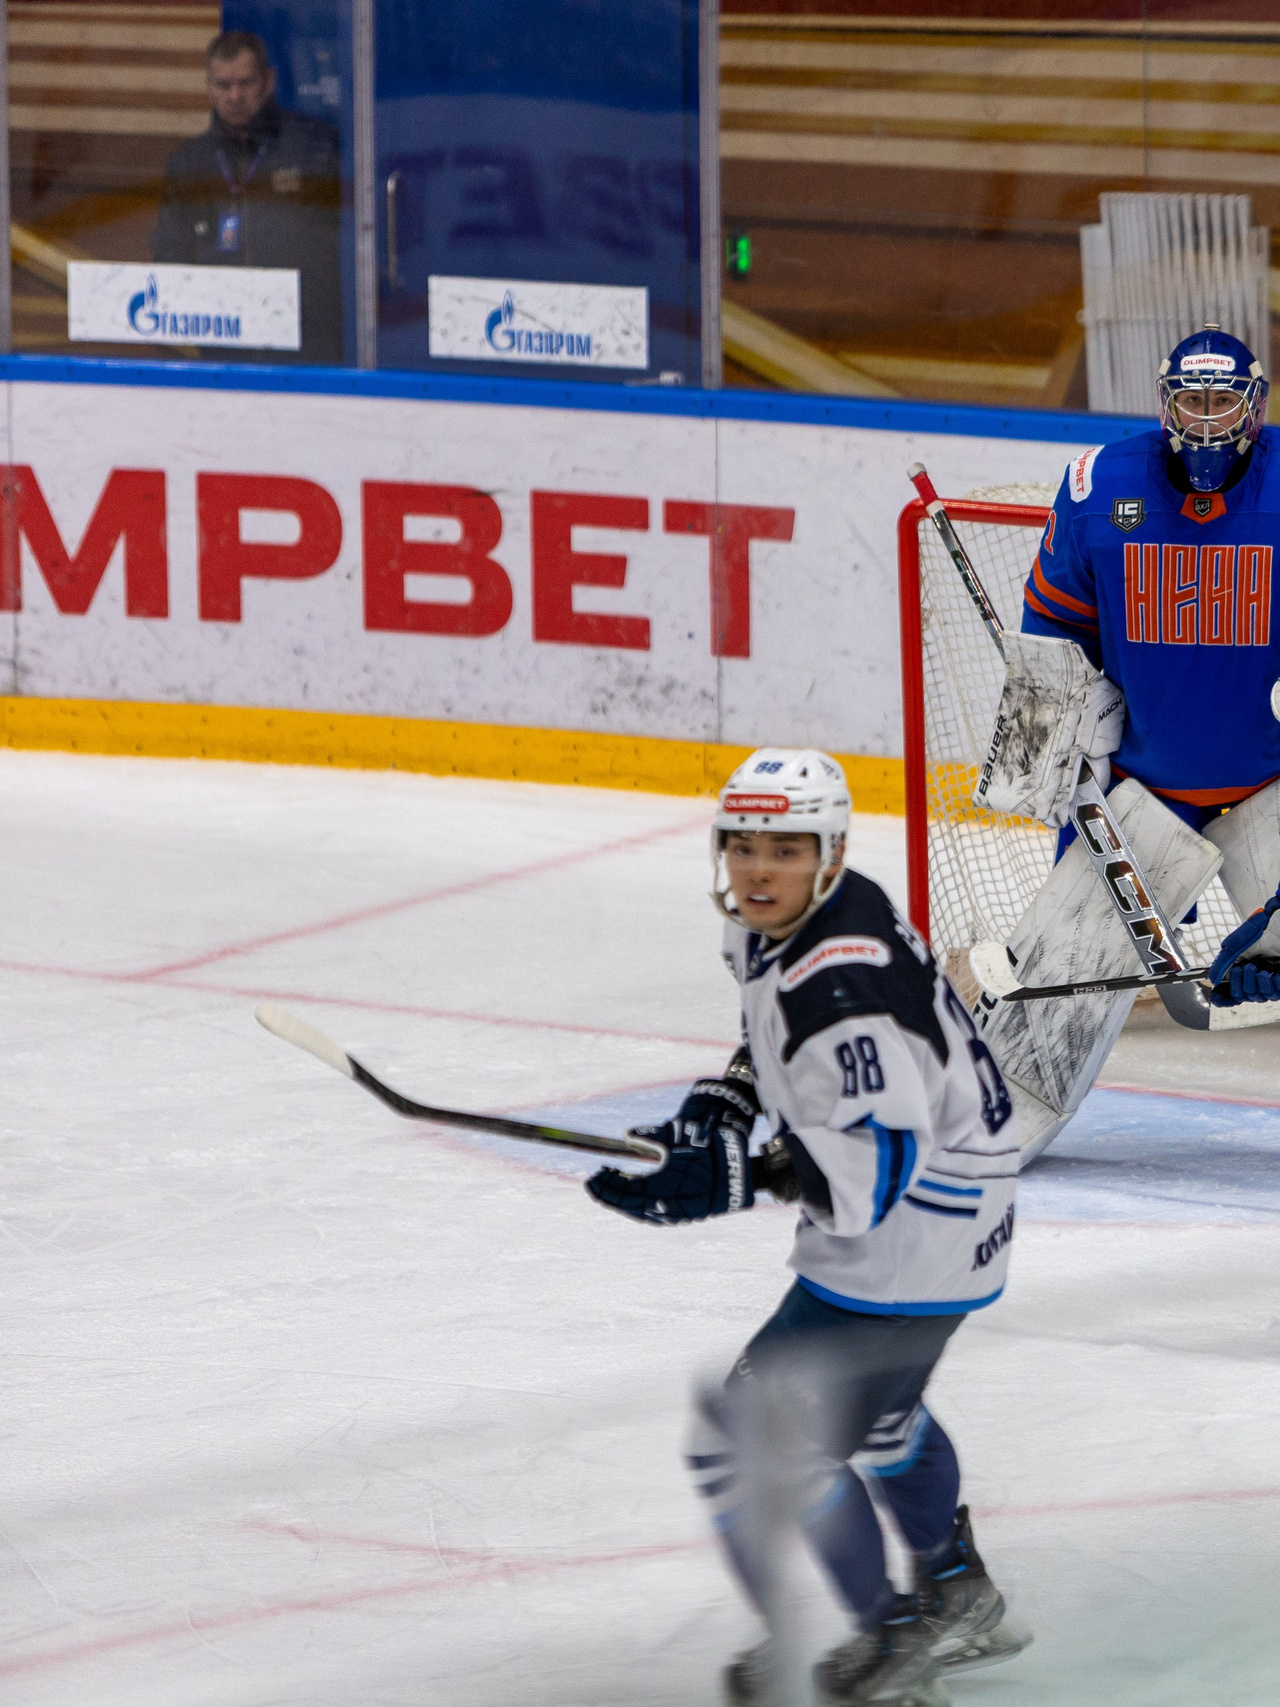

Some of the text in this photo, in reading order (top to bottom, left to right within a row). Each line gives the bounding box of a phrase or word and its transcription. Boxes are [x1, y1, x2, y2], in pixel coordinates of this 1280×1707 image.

[160, 311, 241, 340] ГАЗПРОМ
[516, 329, 593, 358] ГАЗПРОМ
[1183, 357, 1232, 367] OLIMPBET
[0, 463, 796, 659] MPBET
[1097, 698, 1123, 723] MACH
[725, 797, 786, 810] OLIMPBET
[1074, 803, 1189, 975] CCM
[787, 945, 879, 984] OLIMPBET
[1076, 986, 1105, 995] CCM
[834, 1036, 885, 1098] 88
